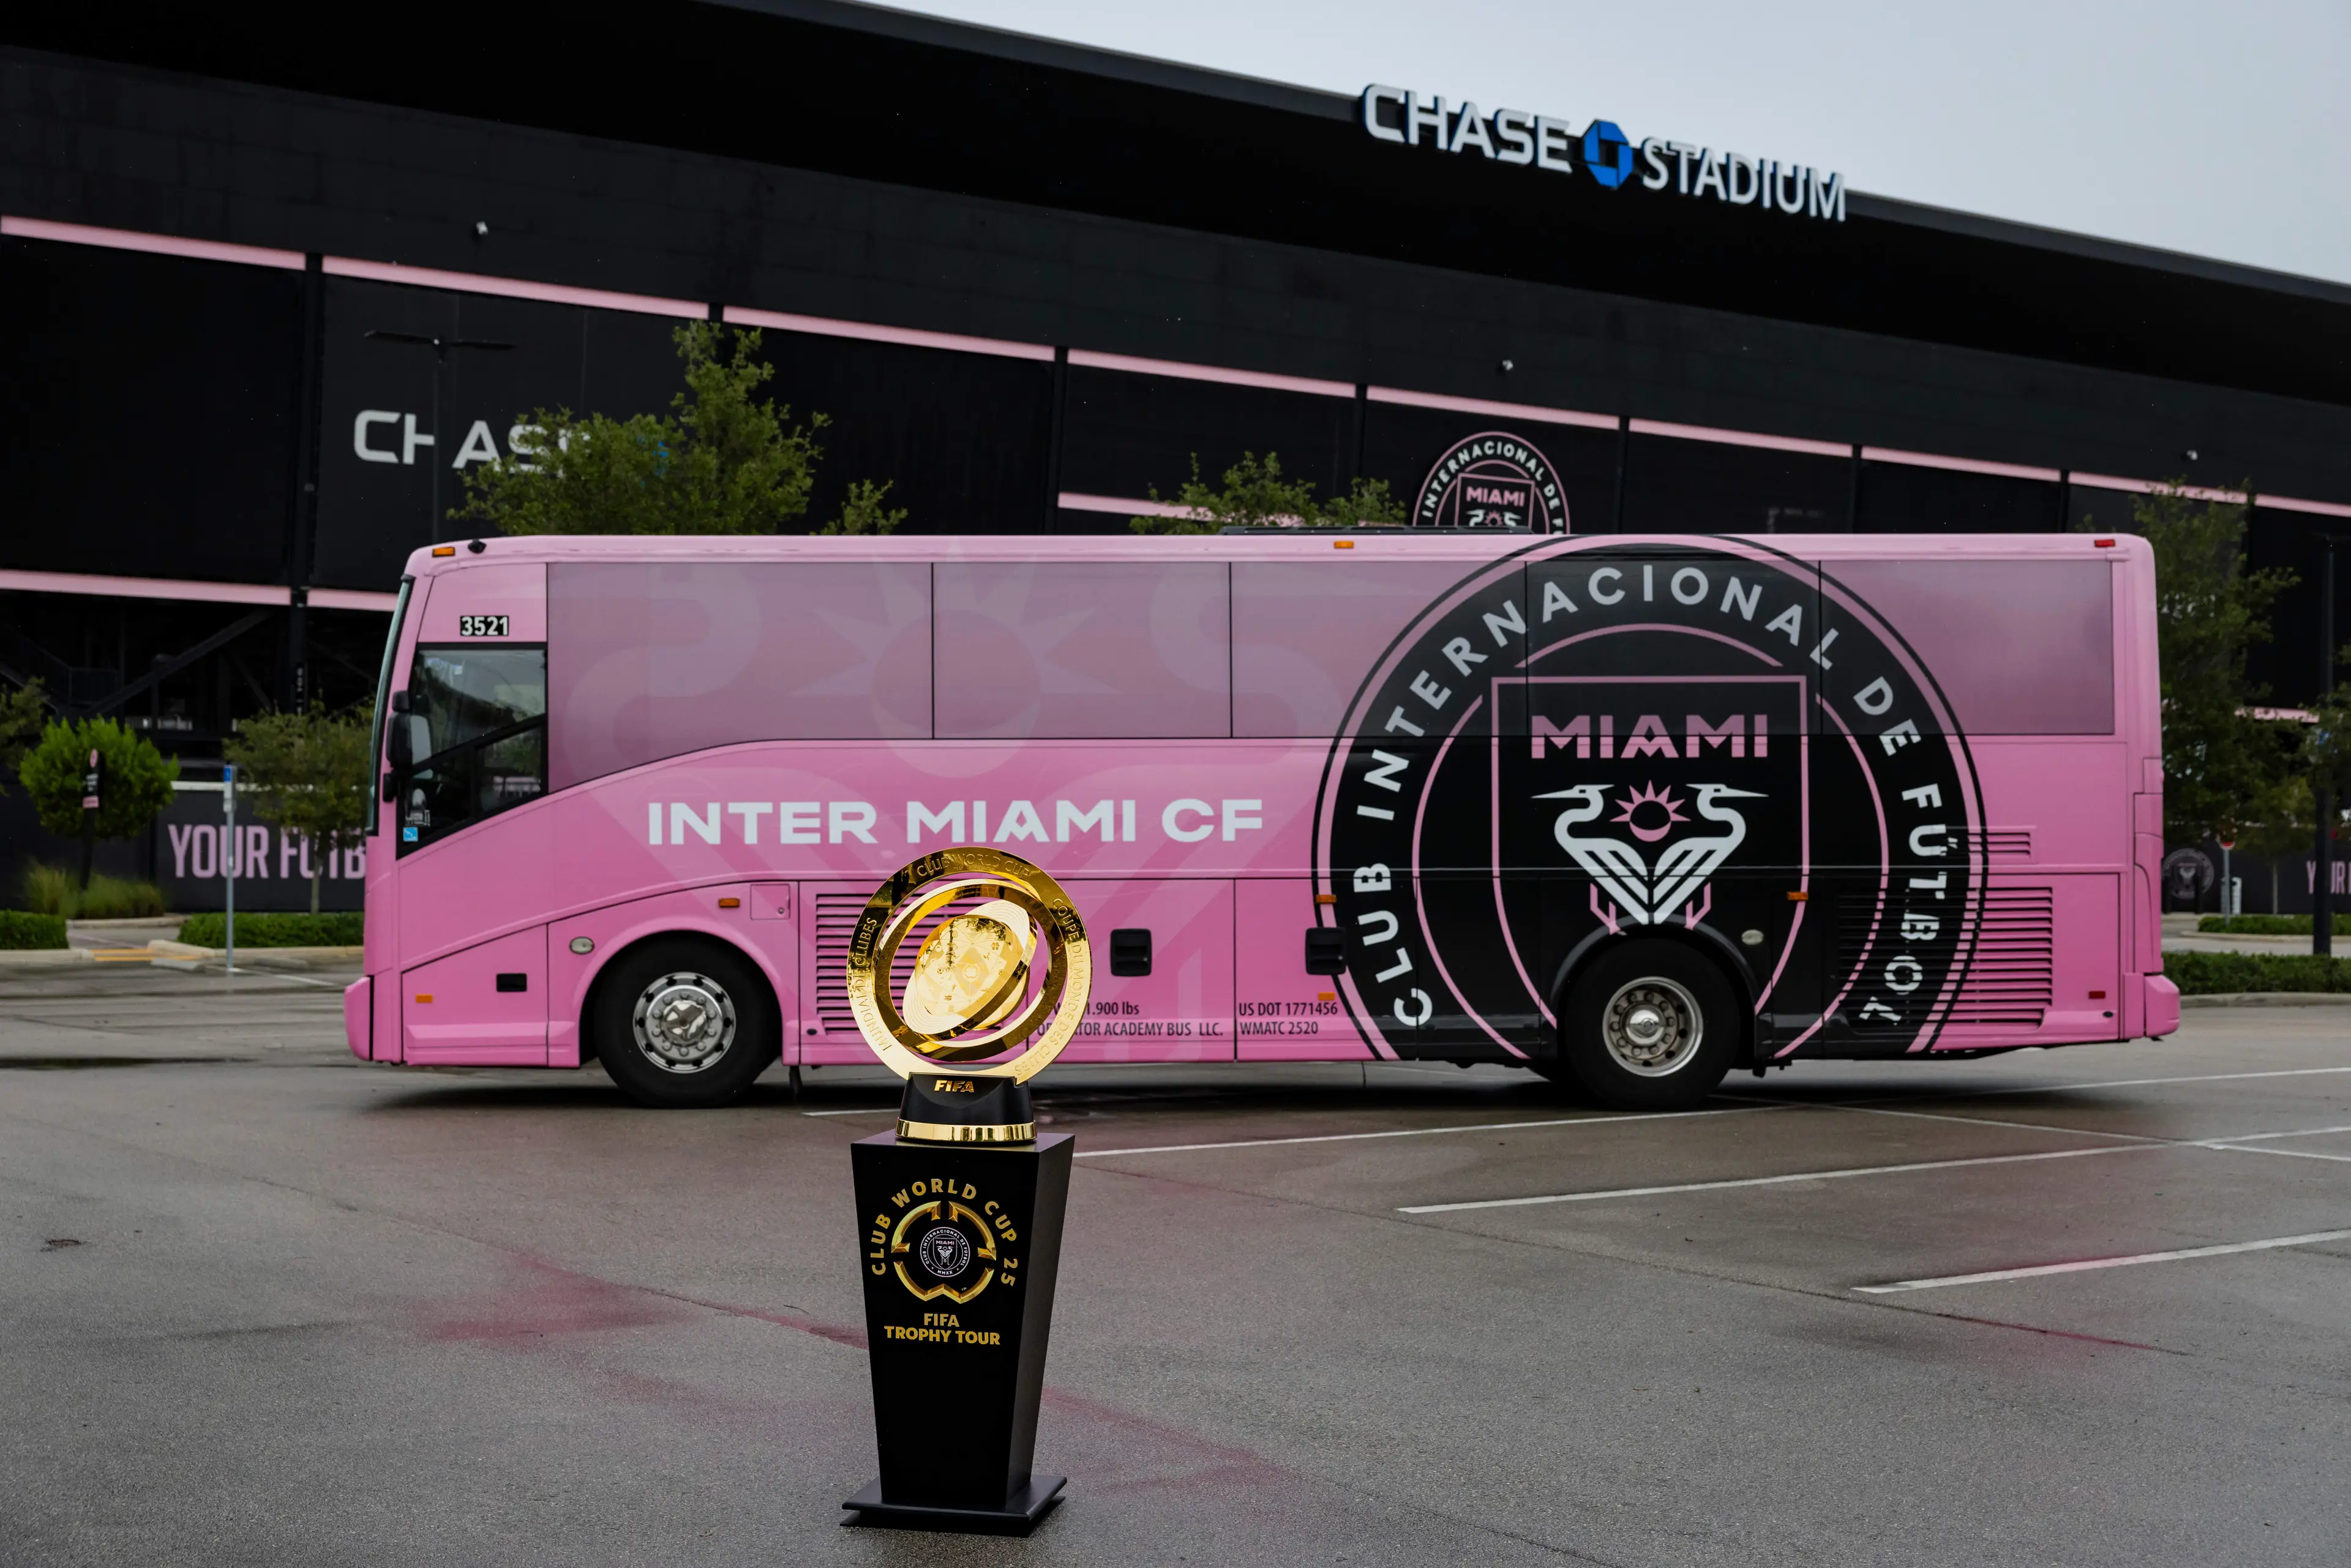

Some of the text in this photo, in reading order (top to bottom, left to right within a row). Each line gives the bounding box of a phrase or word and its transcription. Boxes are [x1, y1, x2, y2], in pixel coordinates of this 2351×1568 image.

[1363, 84, 1846, 222] CHASE STADIUM
[1422, 441, 1561, 518] INTERNACIONAL DE
[1466, 486, 1526, 507] MIAMI
[461, 616, 508, 636] 3521
[1355, 565, 1840, 821] INTERNACIONAL
[1853, 676, 1922, 756] DE
[1531, 714, 1768, 759] MIAMI
[648, 798, 1263, 845] INTER MIAMI CF
[168, 824, 269, 879] YOUR
[917, 853, 1031, 878] CLUB WORLD CUP
[1052, 898, 1080, 940] COUPE
[854, 917, 877, 967] CLUBES
[1353, 862, 1433, 1027] CLUB
[1064, 967, 1084, 1020] MONDE
[1122, 1001, 1139, 1015] lbs
[1239, 1002, 1338, 1016] US DOT 1771456
[1049, 1022, 1069, 1046] DES
[1104, 1022, 1163, 1036] ACADEMY
[1167, 1022, 1191, 1036] BUS
[1199, 1022, 1223, 1036] LLC.
[1240, 1021, 1318, 1035] WMATC 2520
[1014, 1045, 1051, 1076] CLUBS
[934, 1079, 975, 1093] FIFA
[870, 1178, 1018, 1287] CLUB WORLD CUP 25
[923, 1229, 960, 1248] INTERNACIONAL
[884, 1326, 1000, 1345] TROPHY TOUR
[924, 1313, 959, 1327] FIFA
